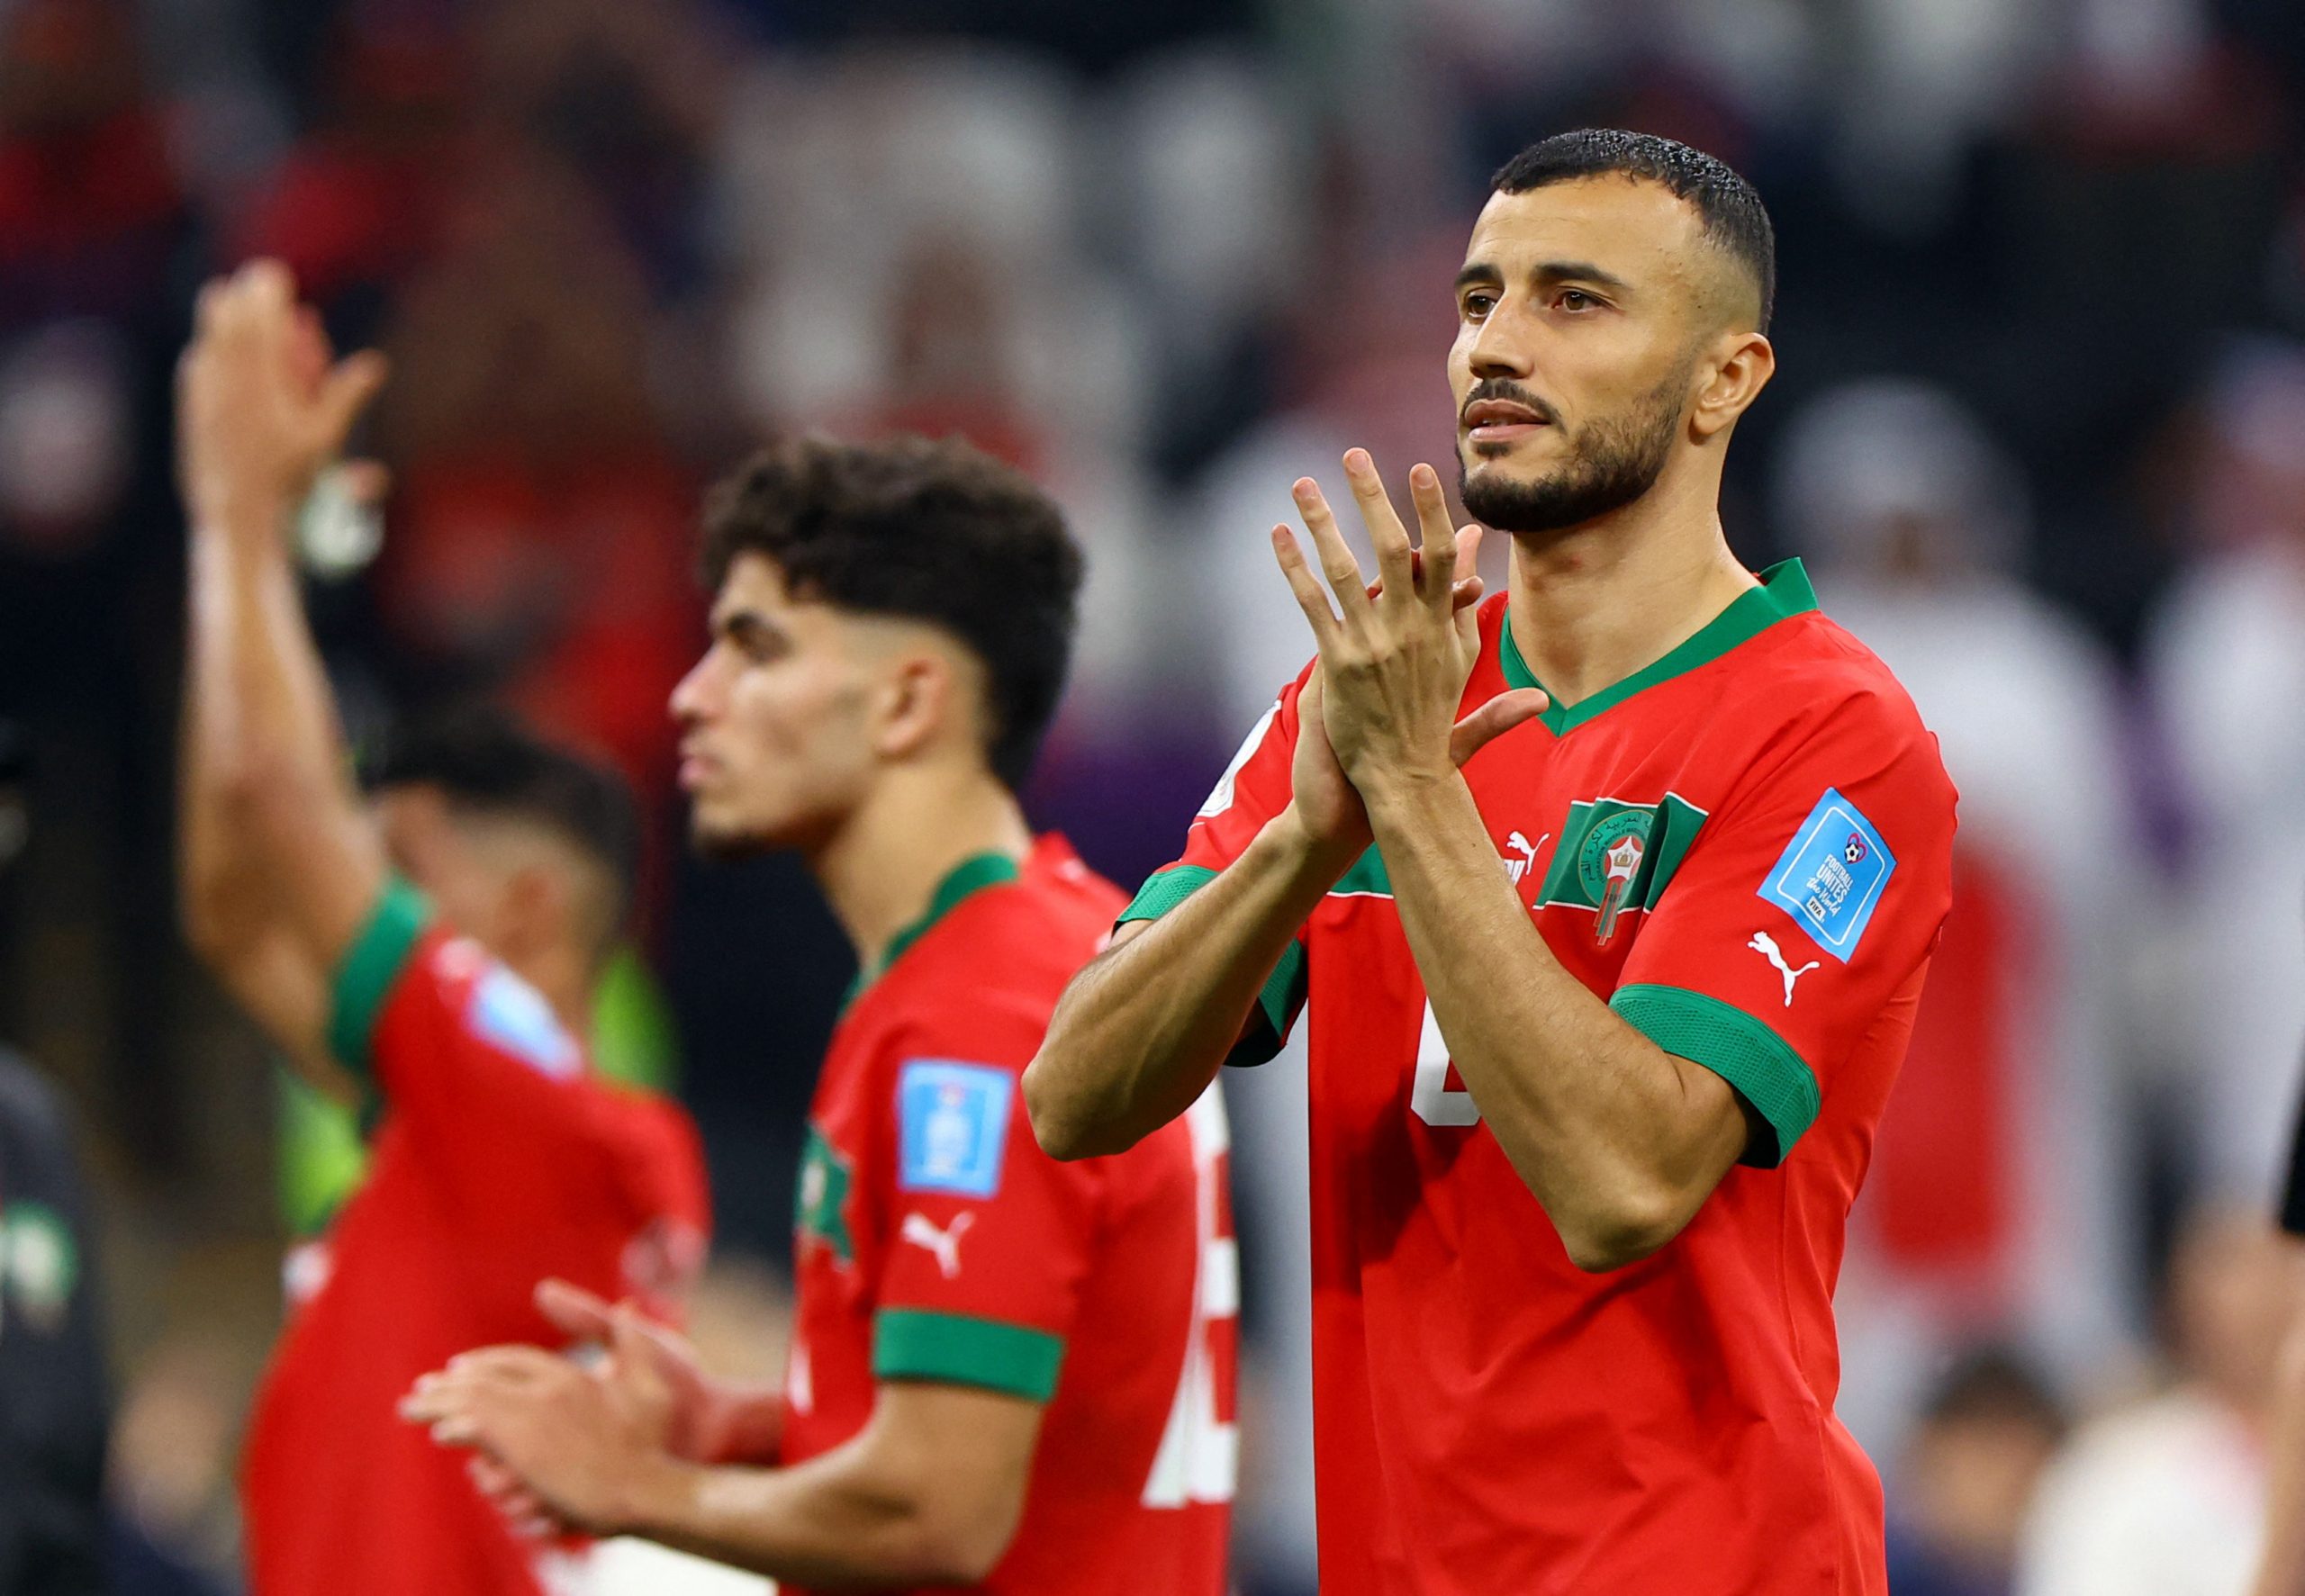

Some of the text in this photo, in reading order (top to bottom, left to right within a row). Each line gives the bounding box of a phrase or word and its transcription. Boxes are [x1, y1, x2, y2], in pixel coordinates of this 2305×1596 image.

[1816, 863, 1848, 903] UNITES
[1824, 853, 1854, 891] FOOTBALL
[1809, 900, 1822, 916] FIFA
[1818, 888, 1842, 917] World
